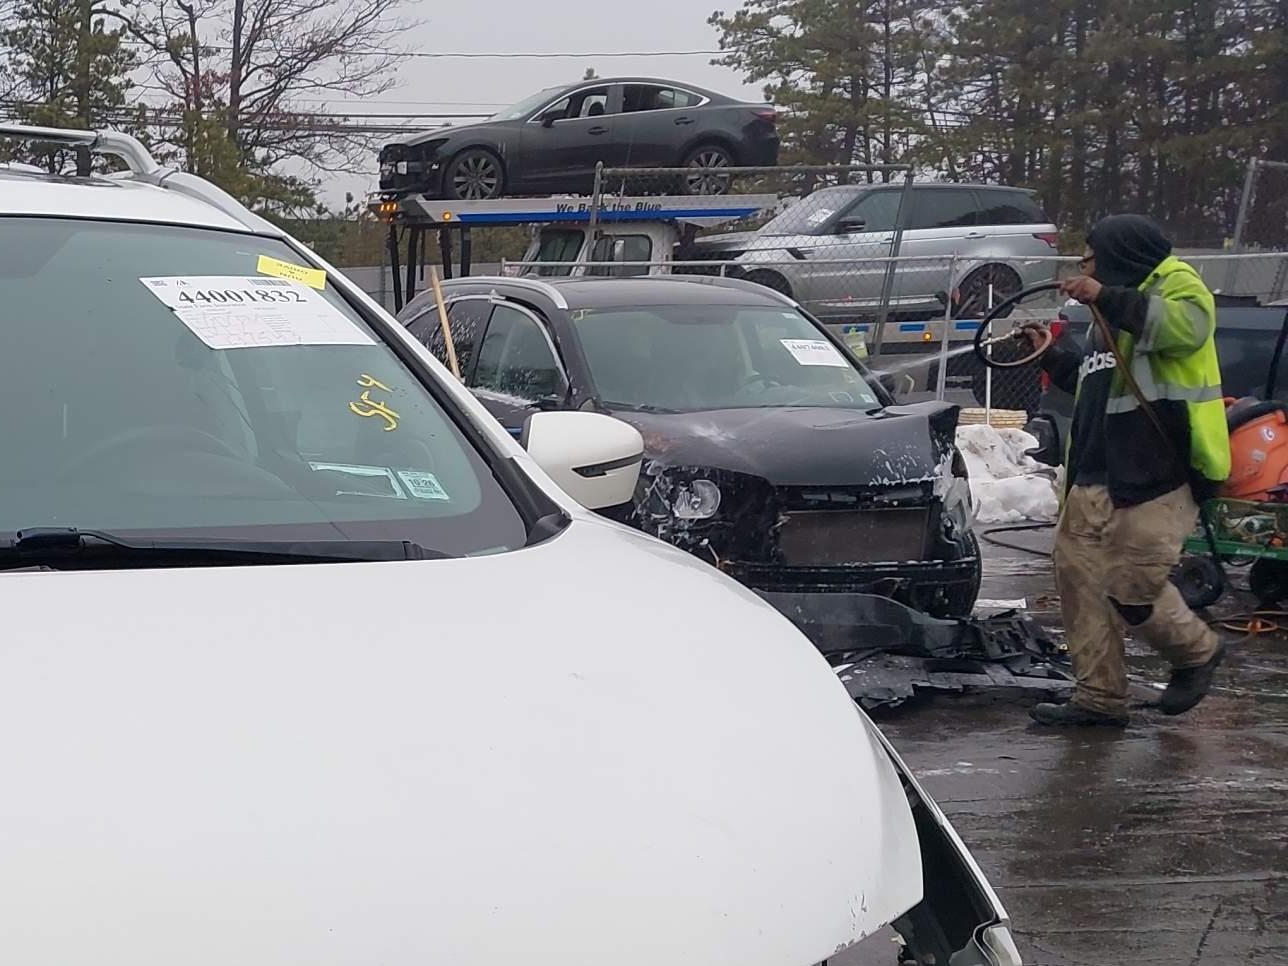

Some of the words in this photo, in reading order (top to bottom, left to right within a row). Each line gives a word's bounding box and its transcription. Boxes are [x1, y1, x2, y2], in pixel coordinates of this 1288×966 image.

[556, 203, 574, 213] We
[578, 202, 609, 212] Bak
[612, 202, 632, 212] the
[635, 202, 663, 211] Blue
[178, 289, 308, 304] 44001832
